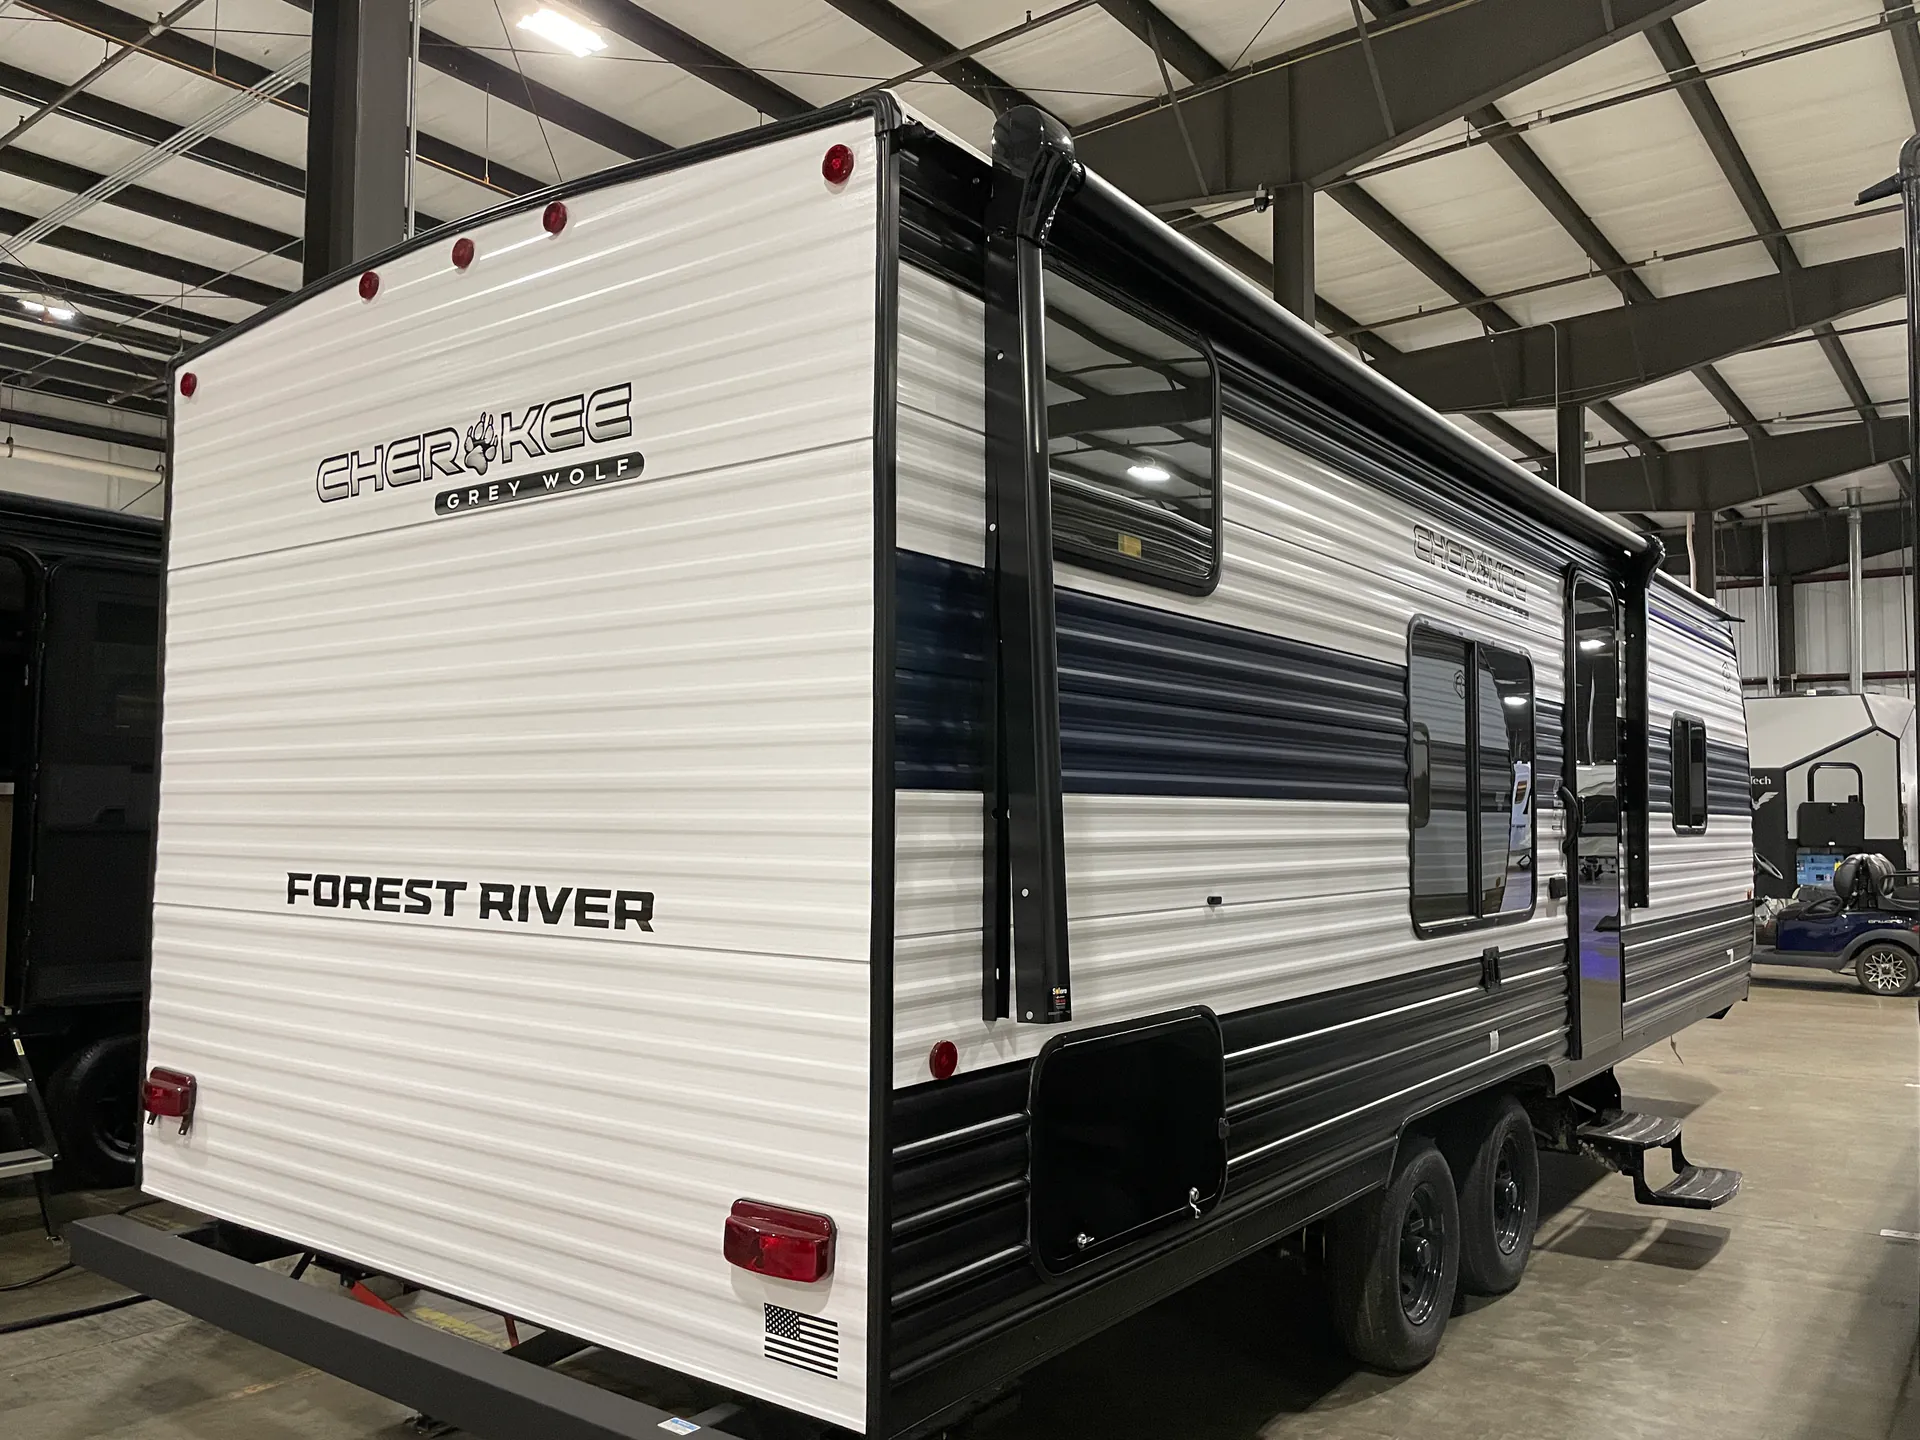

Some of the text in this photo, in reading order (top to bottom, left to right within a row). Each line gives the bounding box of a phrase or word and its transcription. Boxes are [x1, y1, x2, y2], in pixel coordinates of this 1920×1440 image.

[446, 459, 629, 509] GREY WOLF
[287, 872, 655, 932] FOREST RIVER
